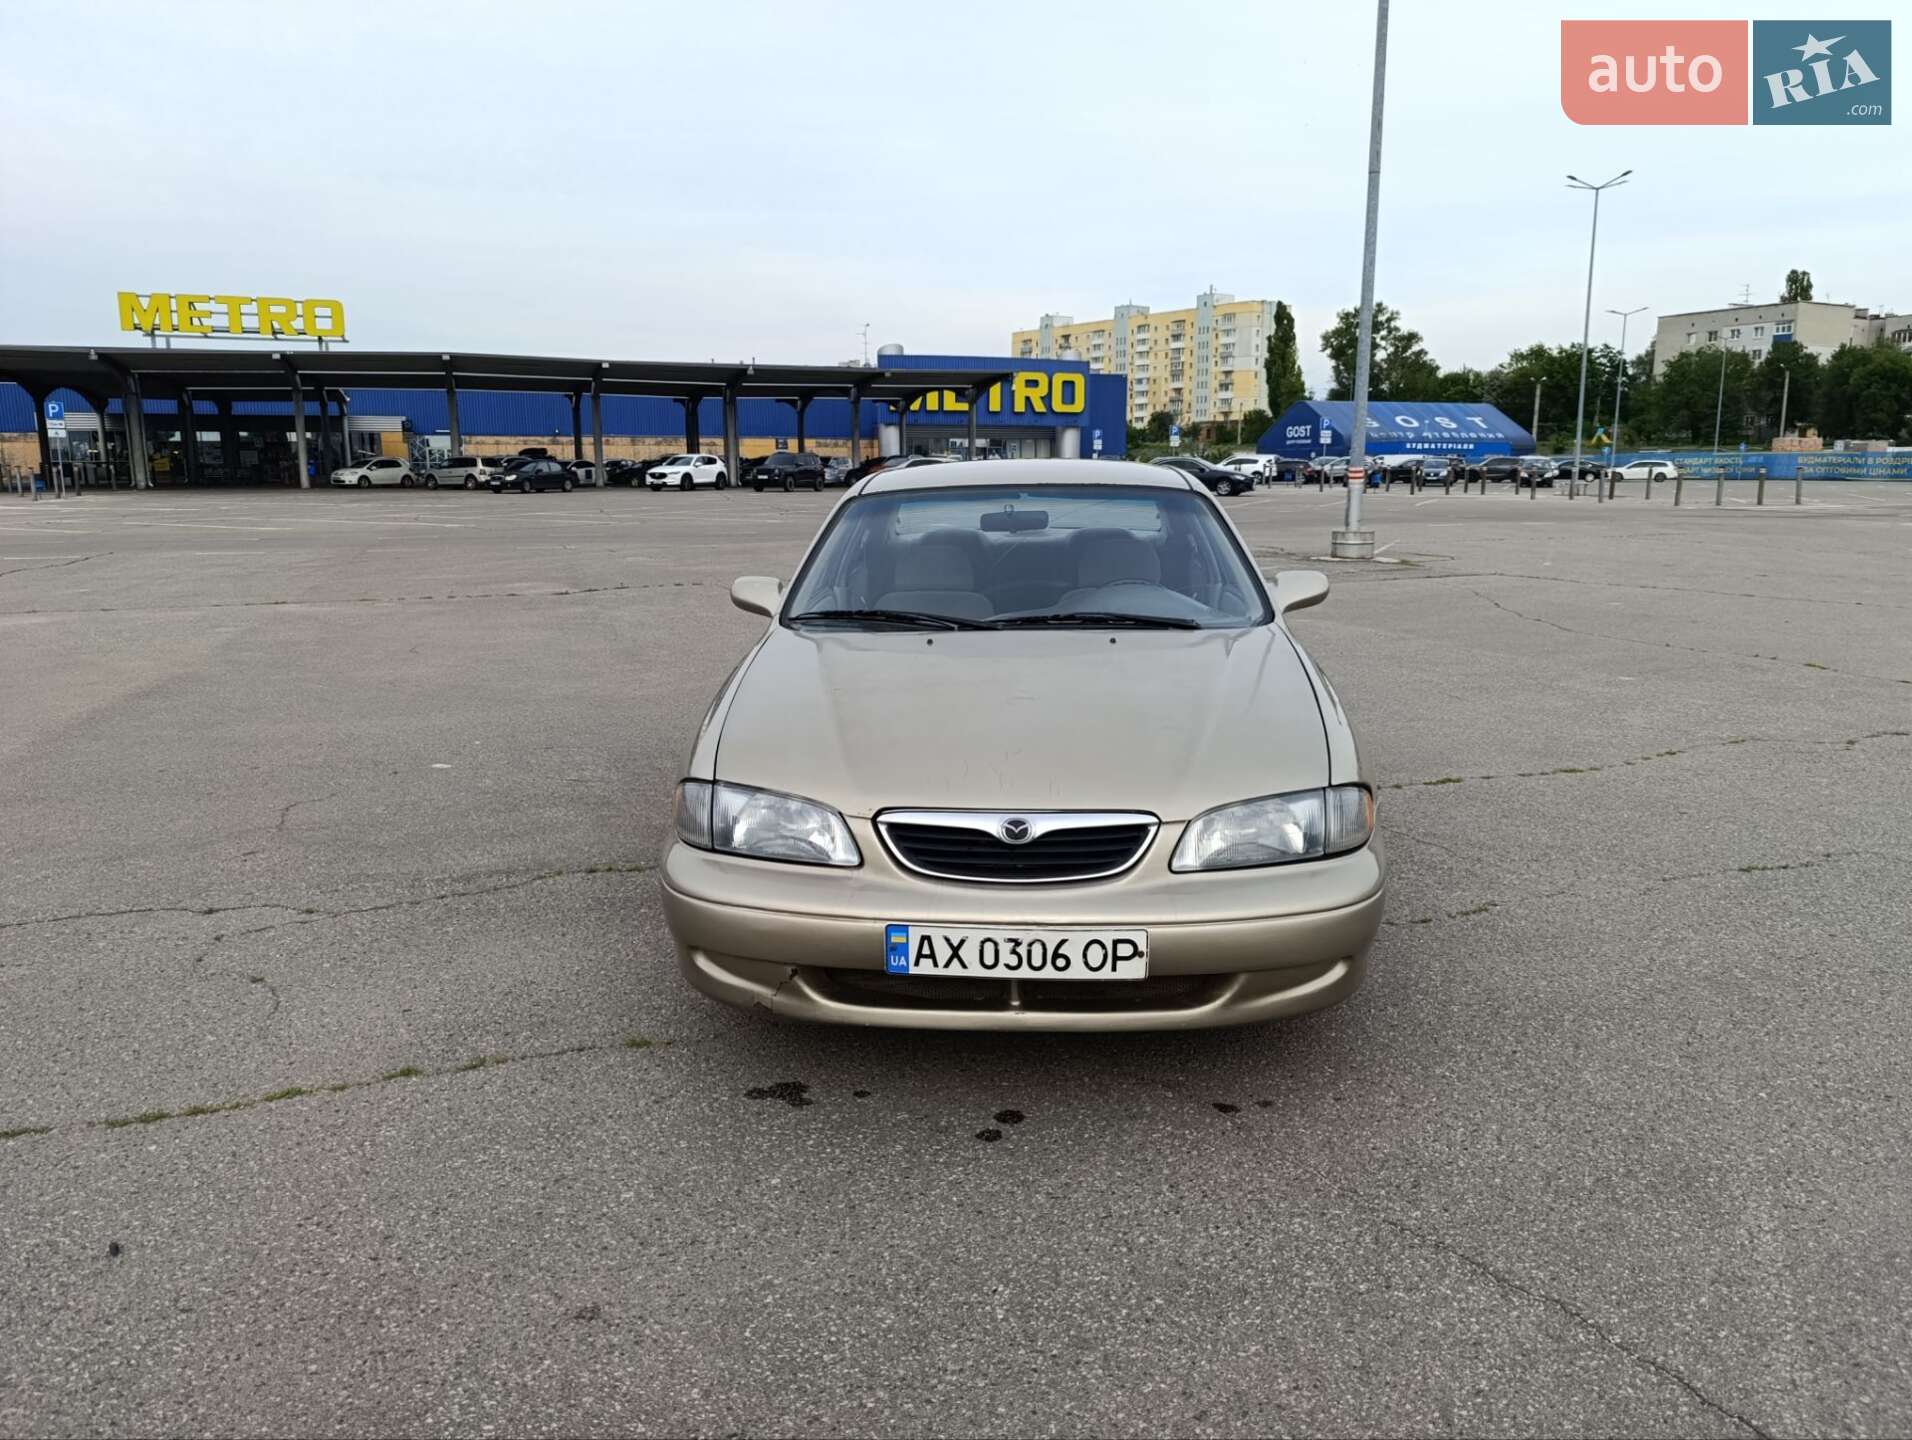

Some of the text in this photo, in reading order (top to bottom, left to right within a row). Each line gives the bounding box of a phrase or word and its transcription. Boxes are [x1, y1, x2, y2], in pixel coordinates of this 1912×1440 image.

[117, 292, 345, 337] METRO
[48, 403, 60, 417] P
[1323, 418, 1330, 430] P
[1286, 425, 1312, 438] GOST
[914, 935, 1139, 972] AX 0306 OP
[890, 955, 908, 967] UA
